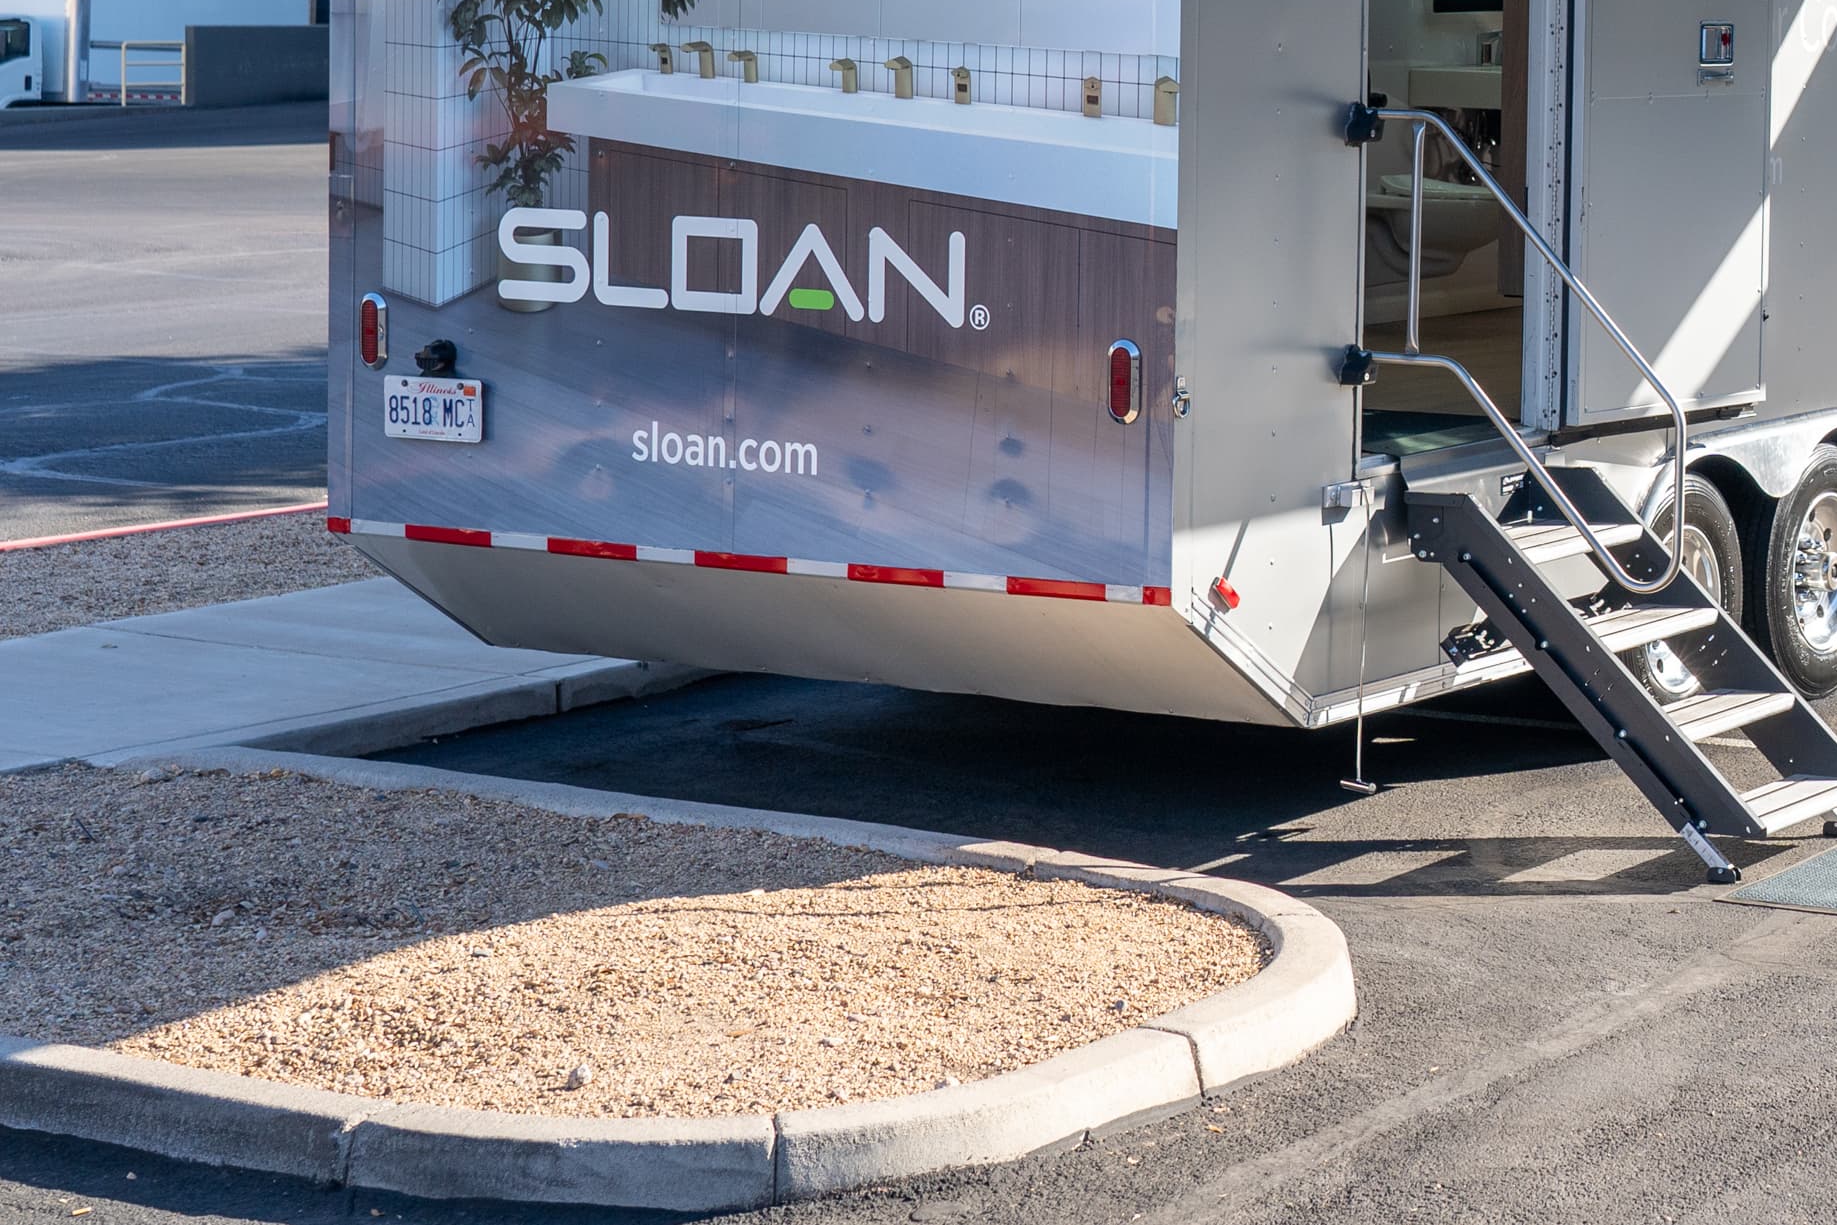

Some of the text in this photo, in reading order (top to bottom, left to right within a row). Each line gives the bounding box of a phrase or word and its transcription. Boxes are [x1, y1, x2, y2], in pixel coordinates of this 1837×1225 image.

[418, 382, 457, 395] Illinois
[389, 395, 432, 426] 8518
[443, 398, 464, 427] MC
[632, 421, 818, 475] sloan.com
